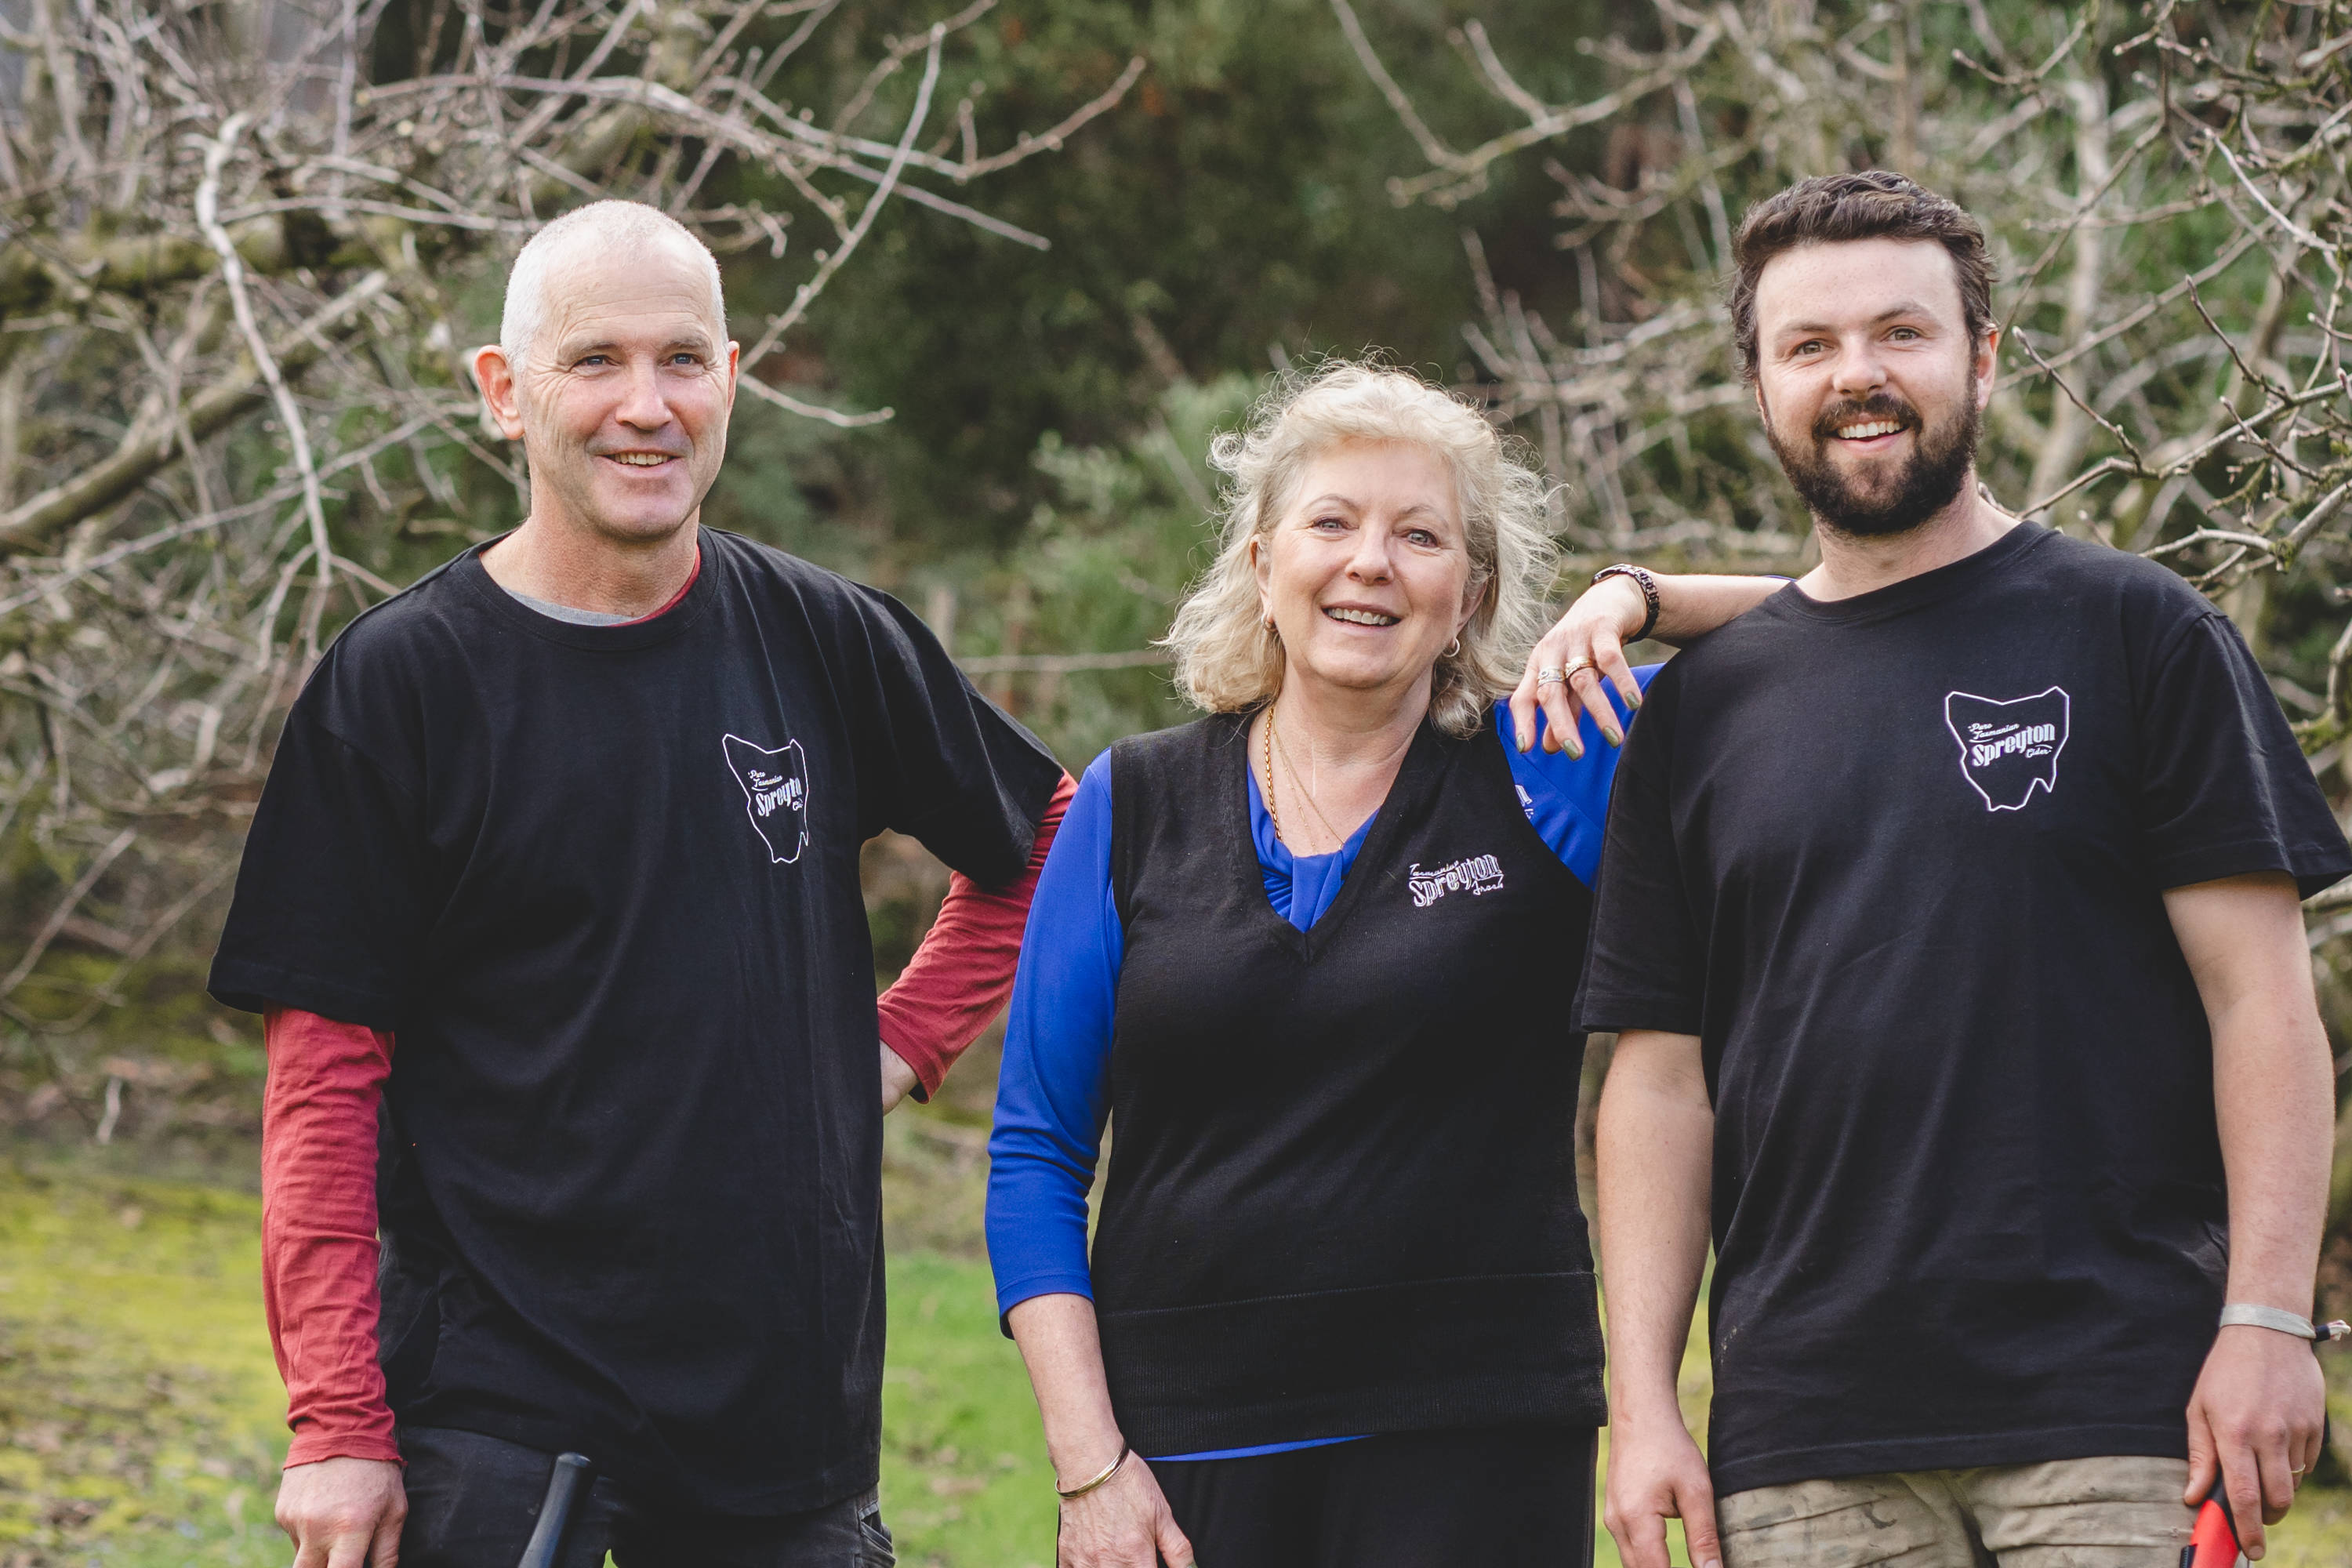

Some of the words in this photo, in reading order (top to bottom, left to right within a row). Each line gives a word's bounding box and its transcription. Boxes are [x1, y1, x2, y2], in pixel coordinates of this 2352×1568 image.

[1973, 724, 2020, 739] Tasmanian
[1973, 724, 2055, 767] Spreyton
[1409, 854, 1501, 907] Spreyton
